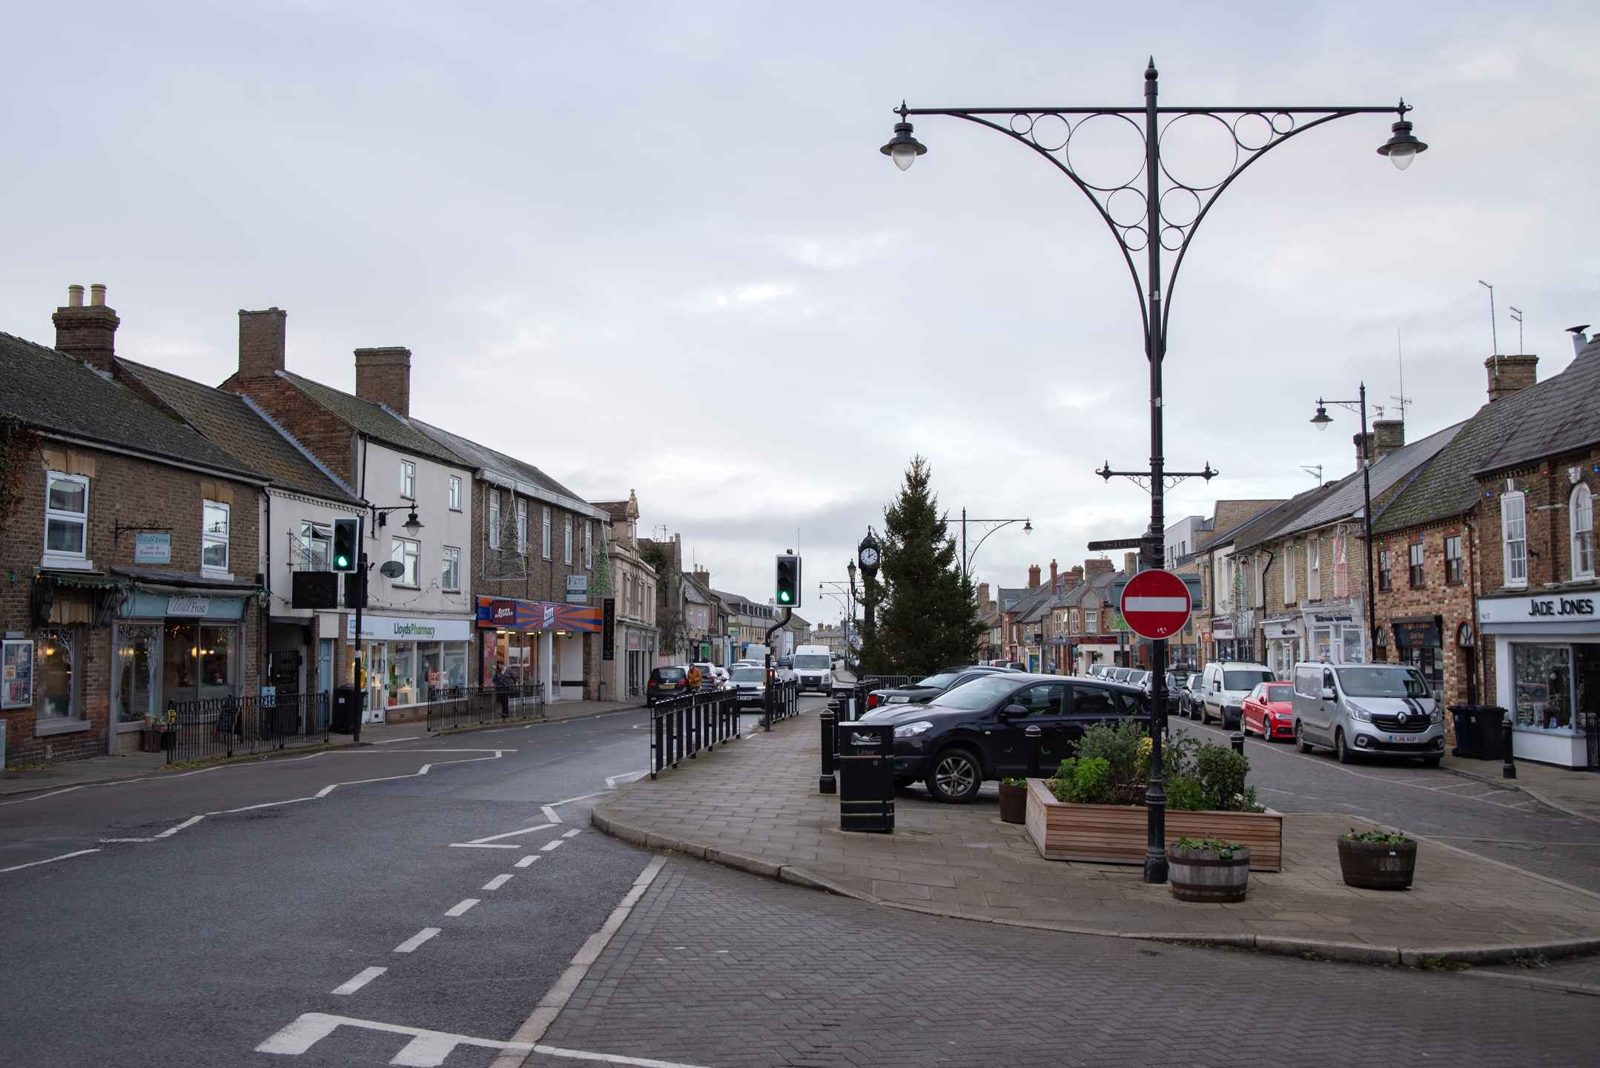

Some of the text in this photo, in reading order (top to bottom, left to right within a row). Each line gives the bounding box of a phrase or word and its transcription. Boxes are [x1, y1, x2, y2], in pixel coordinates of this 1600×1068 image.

[1528, 597, 1594, 616] JADE JONES
[394, 622, 435, 638] LloydsPharmacy
